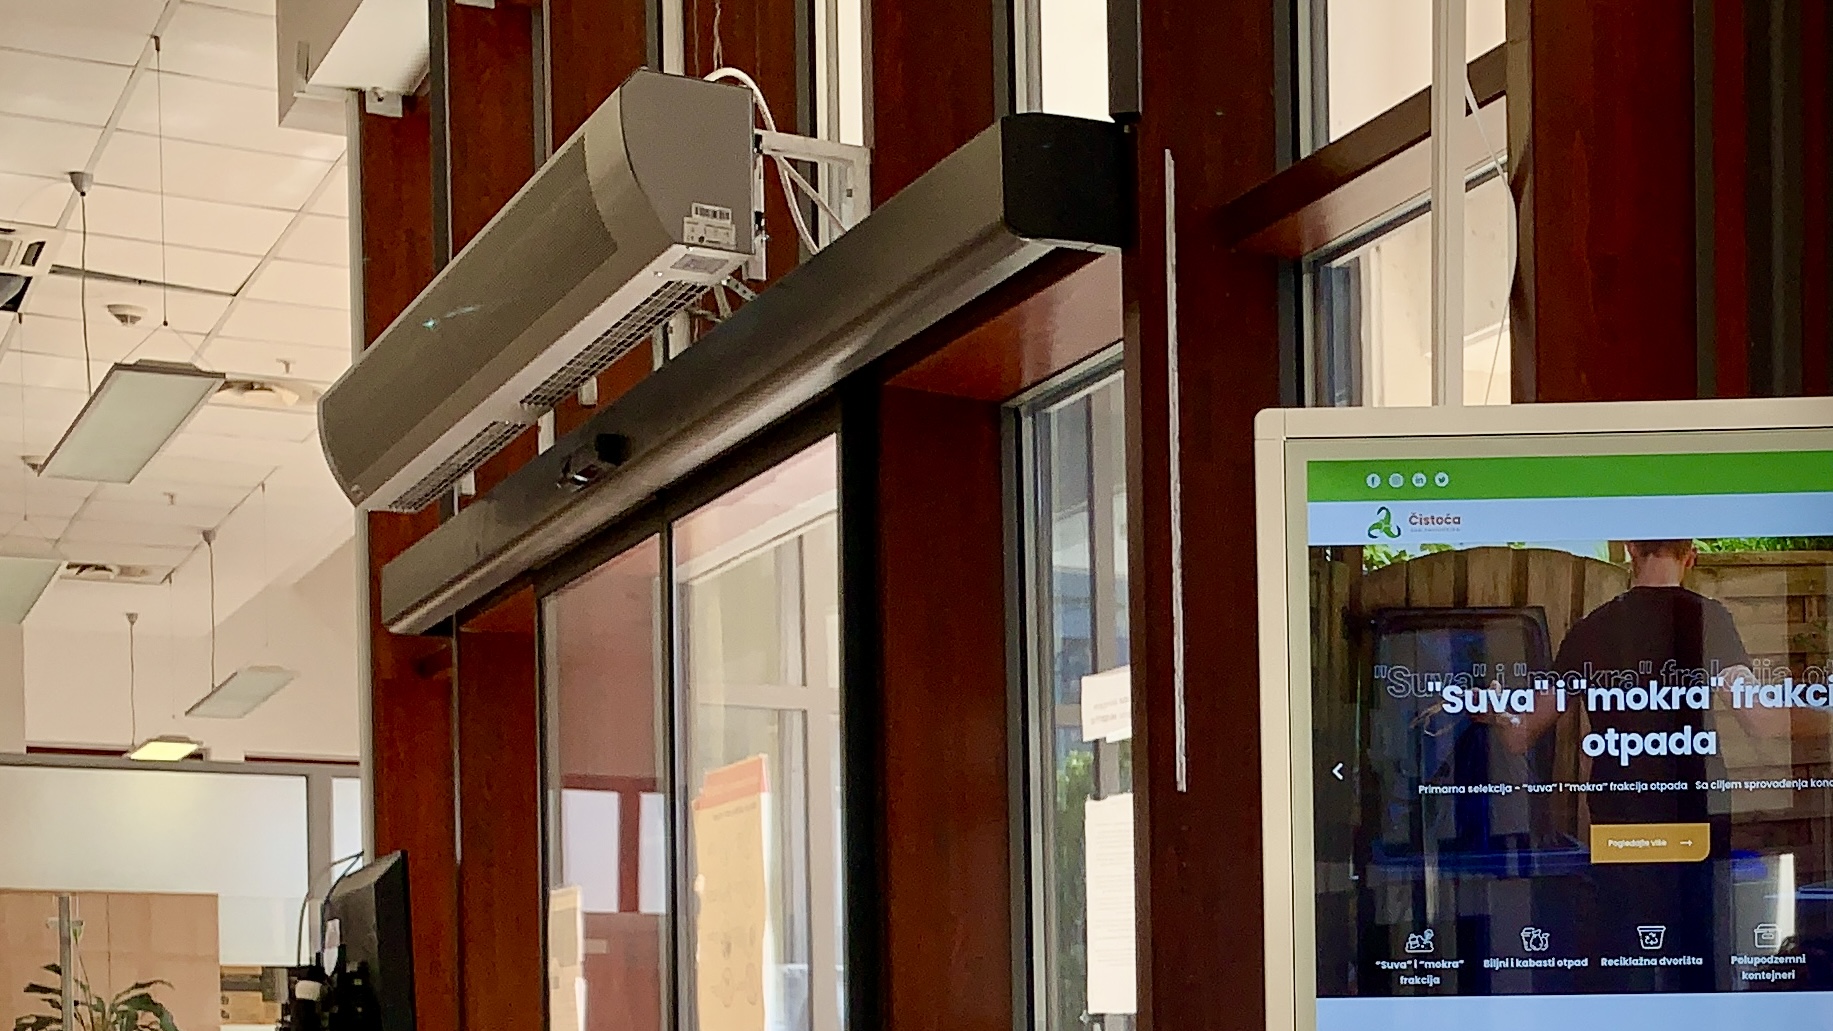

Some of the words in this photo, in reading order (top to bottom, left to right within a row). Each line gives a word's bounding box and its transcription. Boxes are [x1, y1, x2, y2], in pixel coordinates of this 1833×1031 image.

[1408, 511, 1461, 525] Čistoća
[1428, 679, 1548, 713] "Suva"
[1556, 679, 1566, 712] i
[1573, 676, 1724, 712] "mokra"
[1582, 725, 1717, 766] otpada
[1418, 785, 1465, 795] Primarna
[1467, 784, 1513, 796] selekcija
[1610, 782, 1648, 793] frakcija
[1650, 781, 1688, 792] otpada
[1695, 780, 1709, 790] Sa
[1710, 779, 1742, 792] ciljem
[1483, 957, 1510, 970] Biljni
[1516, 957, 1555, 968] kabasti
[1557, 957, 1588, 969] otpad
[1600, 956, 1658, 967] Reciklažna
[1659, 955, 1703, 966] dvorišta
[1731, 954, 1807, 966] Polupodzemni
[1400, 974, 1440, 986] frakcija
[1741, 969, 1795, 982] kontejneri
